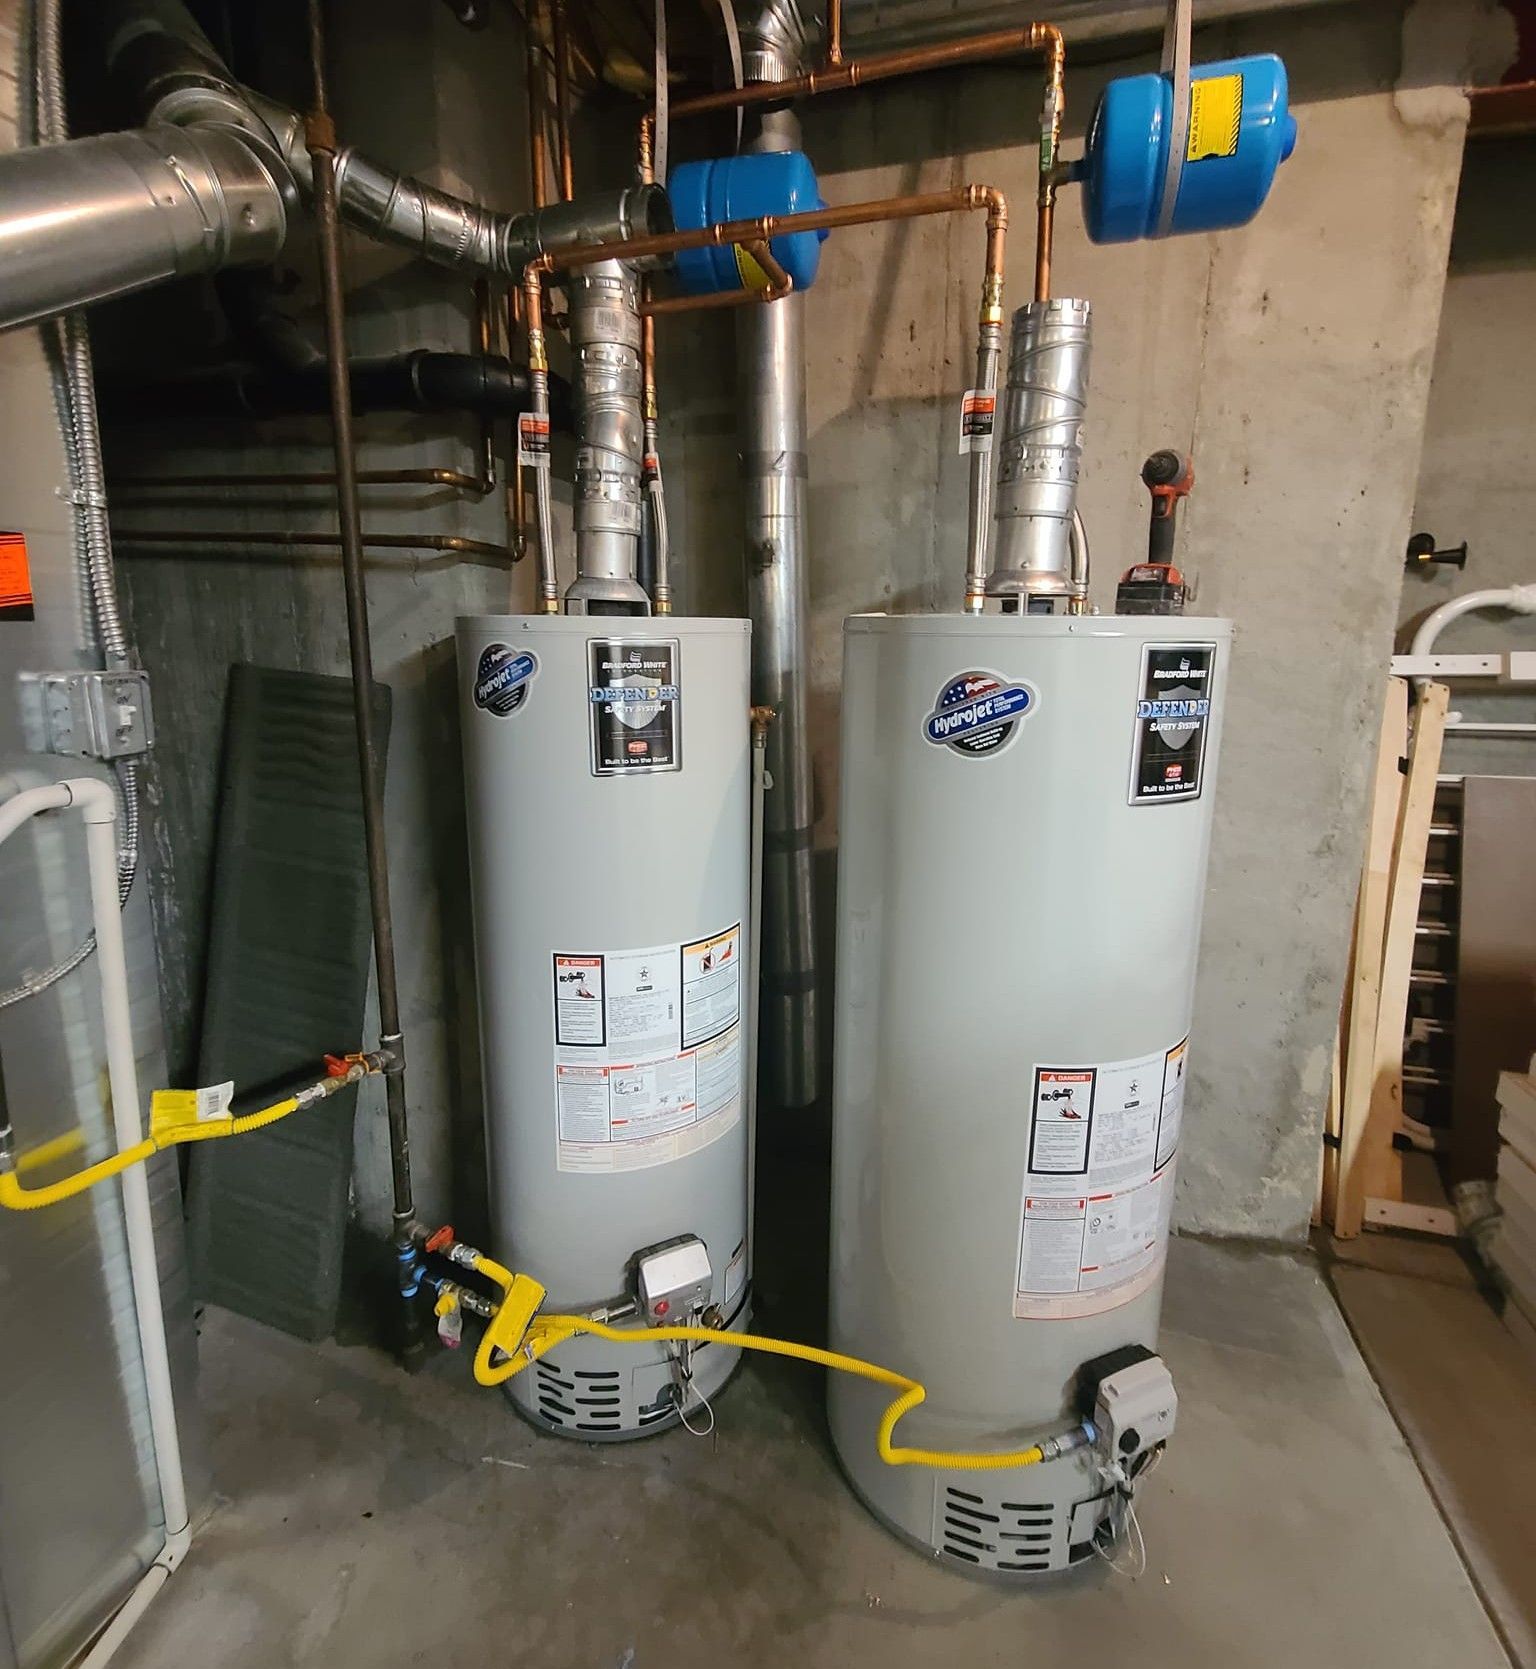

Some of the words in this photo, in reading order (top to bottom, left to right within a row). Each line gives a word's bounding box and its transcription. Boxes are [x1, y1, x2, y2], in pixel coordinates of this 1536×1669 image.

[1192, 88, 1201, 144] WARNING
[643, 661, 668, 669] WHITE
[1154, 670, 1189, 678] BRADFORD
[479, 668, 511, 699] Hydrojet
[591, 685, 679, 702] DEFENDER
[1138, 699, 1209, 717] DEFENDER
[934, 700, 993, 734] Hydrojet
[1149, 722, 1177, 731] SAFETY
[1177, 721, 1200, 730] SYSTEM
